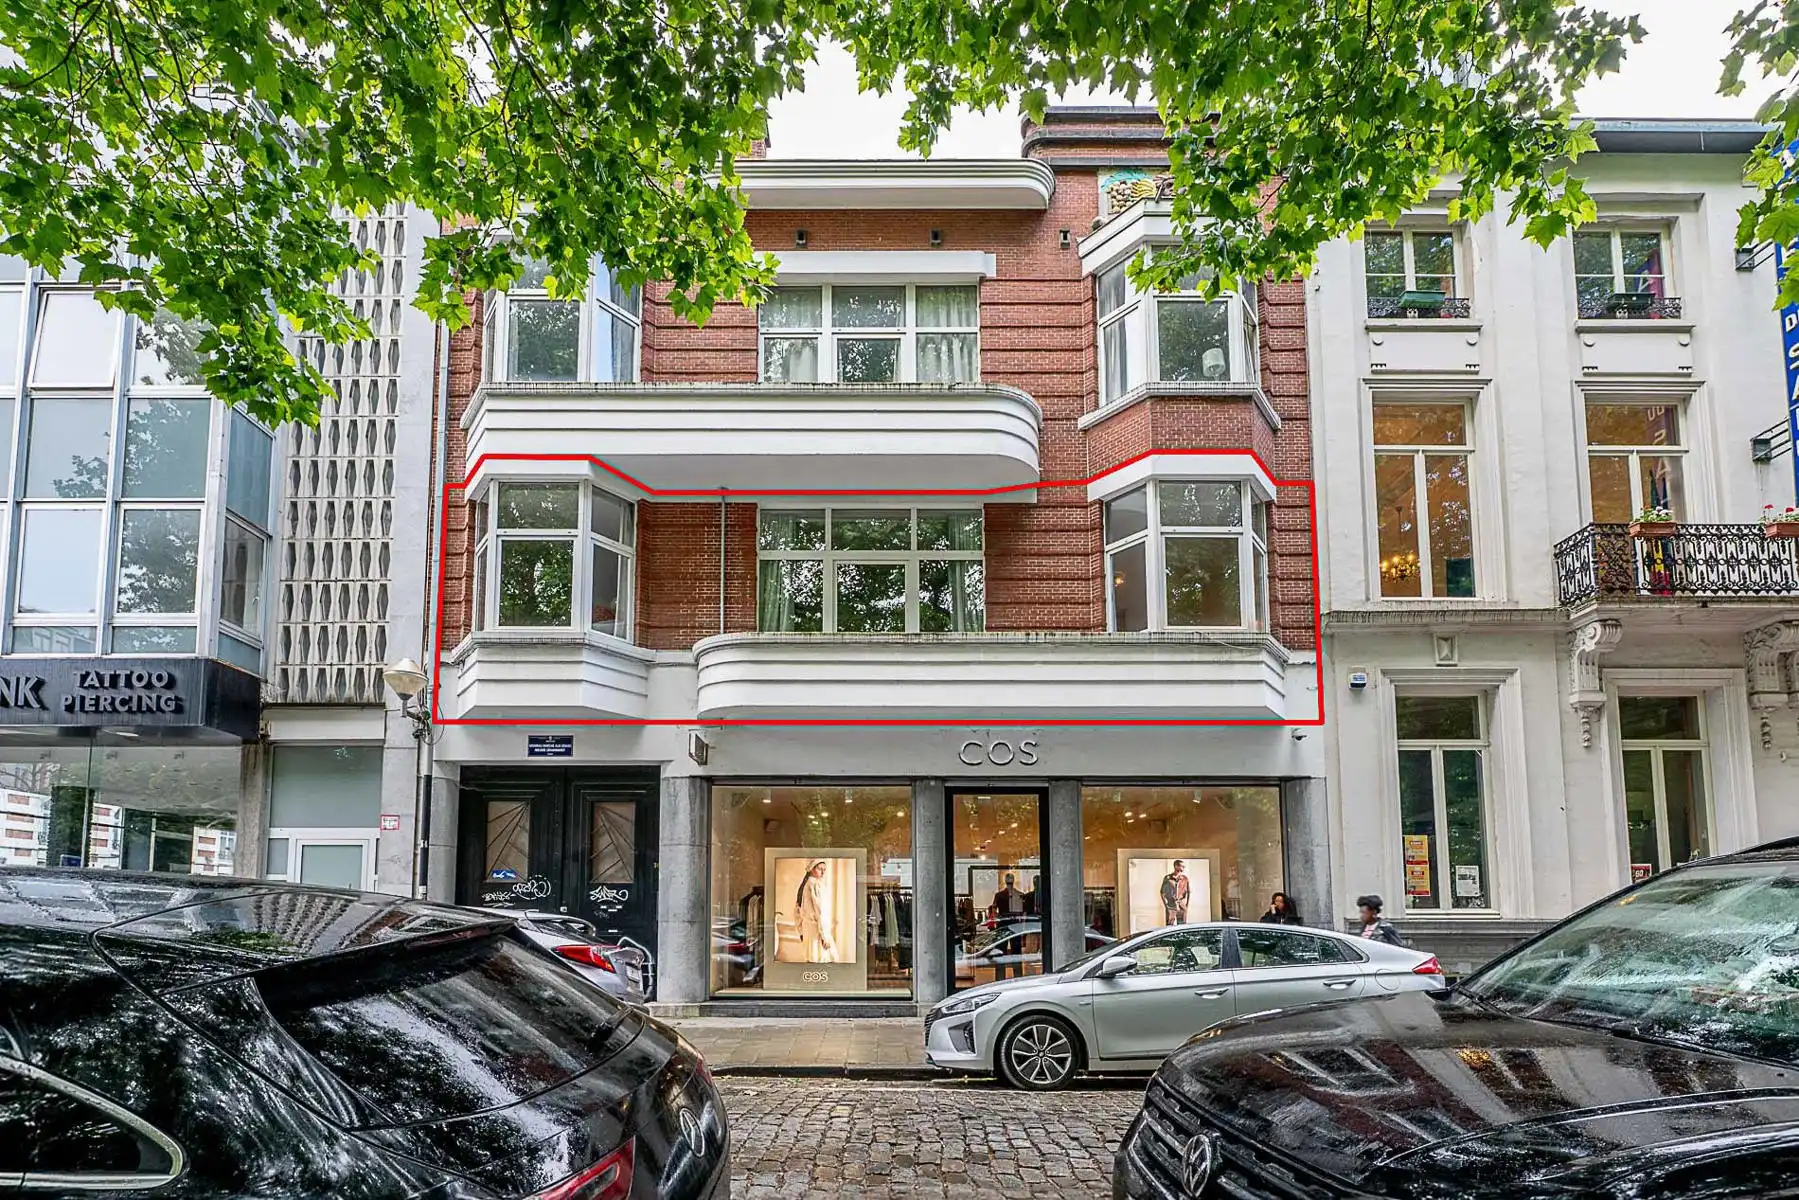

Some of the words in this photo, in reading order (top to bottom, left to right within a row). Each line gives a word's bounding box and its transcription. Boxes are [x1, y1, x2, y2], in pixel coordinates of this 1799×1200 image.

[73, 669, 170, 688] TATTOO
[61, 693, 177, 712] PIERCING
[959, 740, 1039, 766] COS
[802, 971, 829, 983] COS
